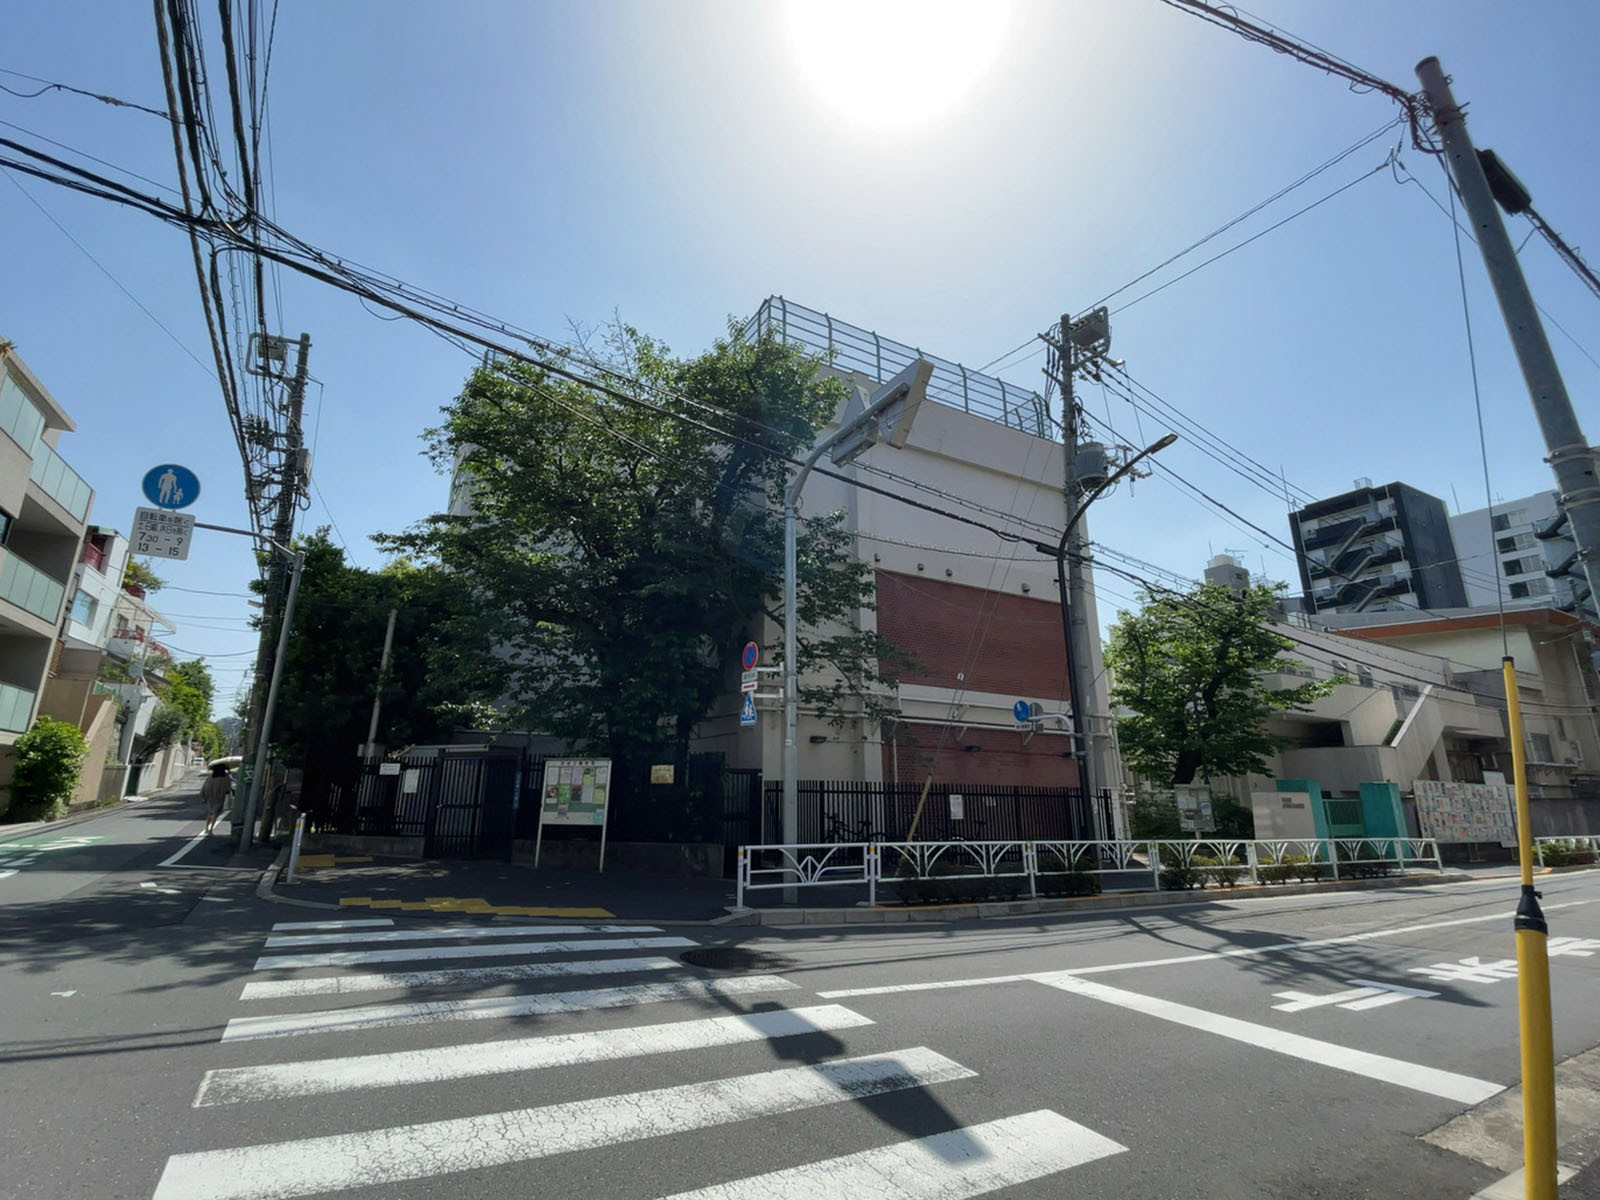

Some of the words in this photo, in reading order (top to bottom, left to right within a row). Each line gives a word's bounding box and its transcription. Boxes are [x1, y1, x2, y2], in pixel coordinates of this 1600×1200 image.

[176, 537, 184, 546] 9
[138, 543, 149, 552] 13
[168, 547, 179, 556] 15
